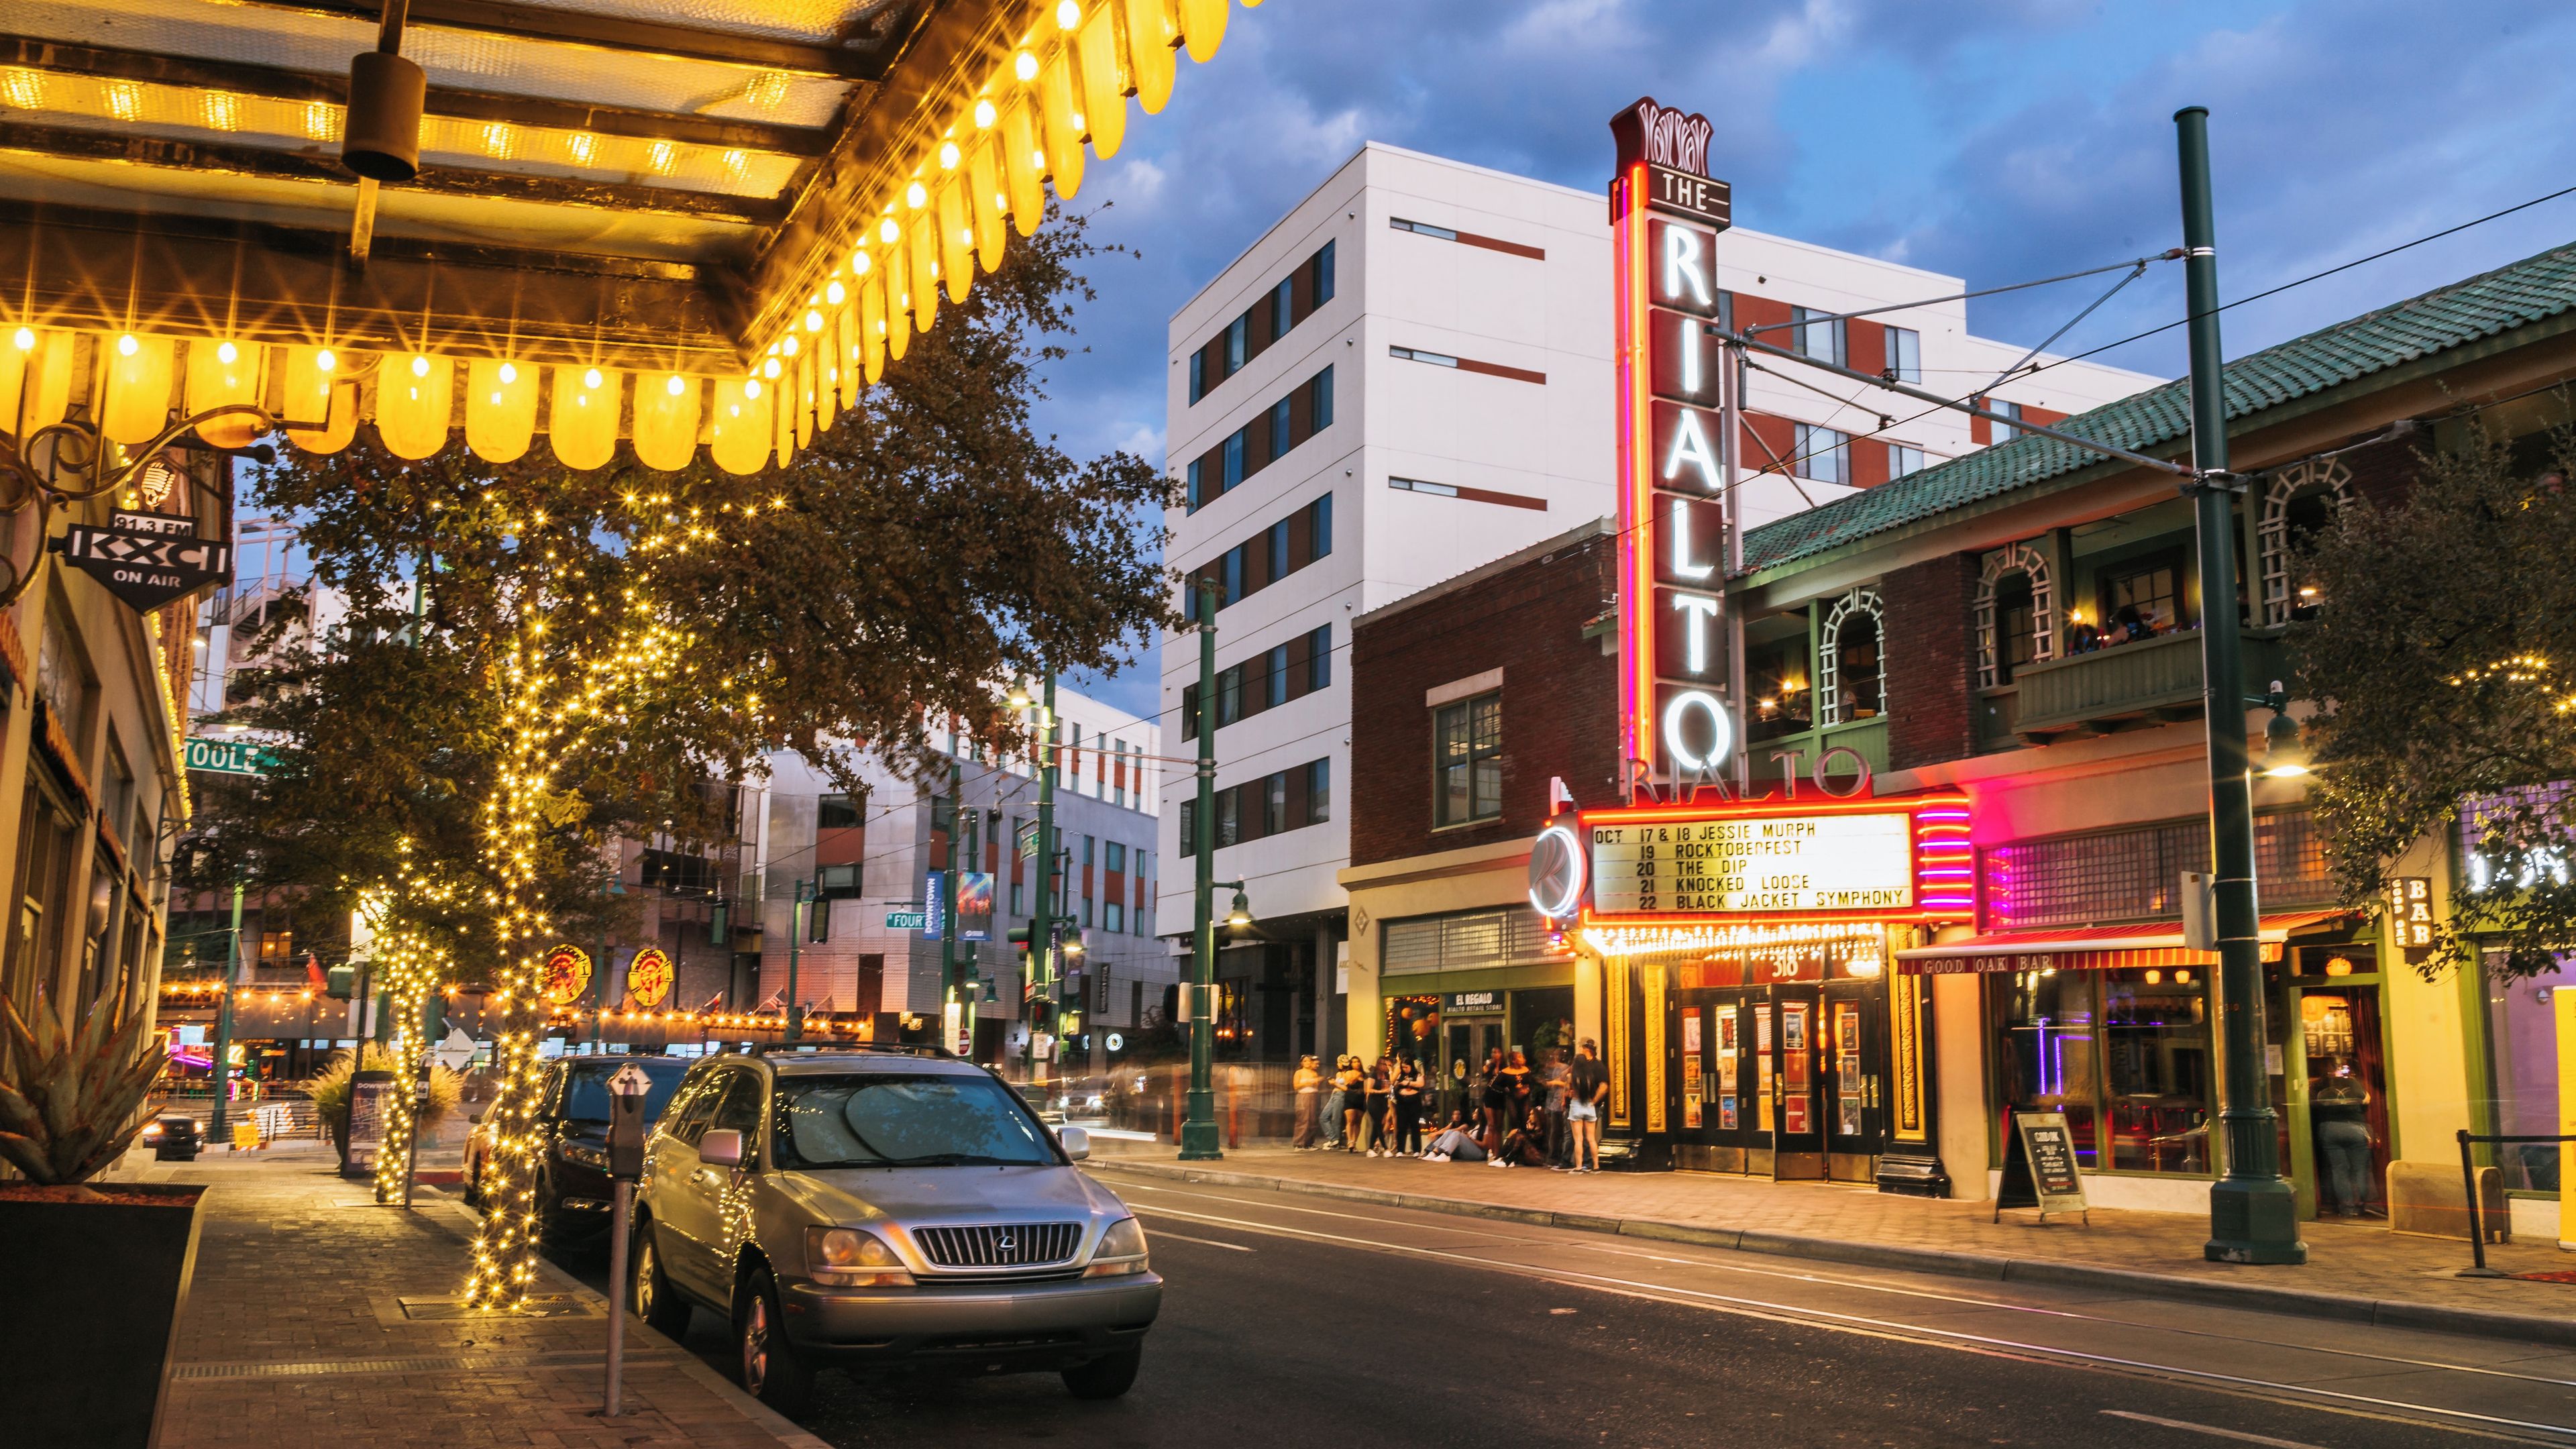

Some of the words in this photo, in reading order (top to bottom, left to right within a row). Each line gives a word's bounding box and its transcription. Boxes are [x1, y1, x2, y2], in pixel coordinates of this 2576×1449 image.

[1662, 172, 1707, 211] THE
[1664, 223, 1731, 770] RIALTO
[115, 517, 156, 533] 91.3
[162, 523, 193, 537] FM
[113, 570, 142, 584] ON
[147, 574, 181, 588] AIR
[183, 741, 260, 773] TOOLE
[1626, 746, 1871, 807] RIALTO
[1595, 830, 1623, 843] OCT
[1640, 828, 1654, 842] 17
[1659, 828, 1669, 841] &
[1676, 827, 1690, 841] 18
[1699, 825, 1750, 840] JESSIE
[1763, 822, 1815, 837] MURPH
[1641, 845, 1655, 859] 19
[1676, 841, 1801, 858] ROCKTOBERFEST
[1637, 861, 1655, 876] 20
[1676, 861, 1704, 875] THE
[1722, 859, 1747, 873] DIP
[1640, 879, 1655, 893] 21
[1676, 877, 1743, 892] KNOCKED
[1762, 875, 1809, 890] LOOSE
[924, 878, 935, 934] DOWNTOWN
[1639, 896, 1656, 910] 22
[1676, 894, 1725, 909] BLACK
[1741, 893, 1799, 908] JACKET
[1817, 890, 1903, 906] SYMPHONY
[2392, 879, 2404, 914] GOOD
[894, 914, 924, 927] FOUR
[932, 898, 941, 933] TUCSON
[2409, 880, 2432, 944] BAR
[2395, 920, 2407, 946] OAK
[1772, 945, 1799, 977] 318
[1924, 959, 1964, 973] GOOD
[1976, 957, 2007, 972] OAK
[2019, 955, 2052, 971] BAR
[1456, 994, 1464, 1006] EL
[1465, 992, 1493, 1006] REGALO
